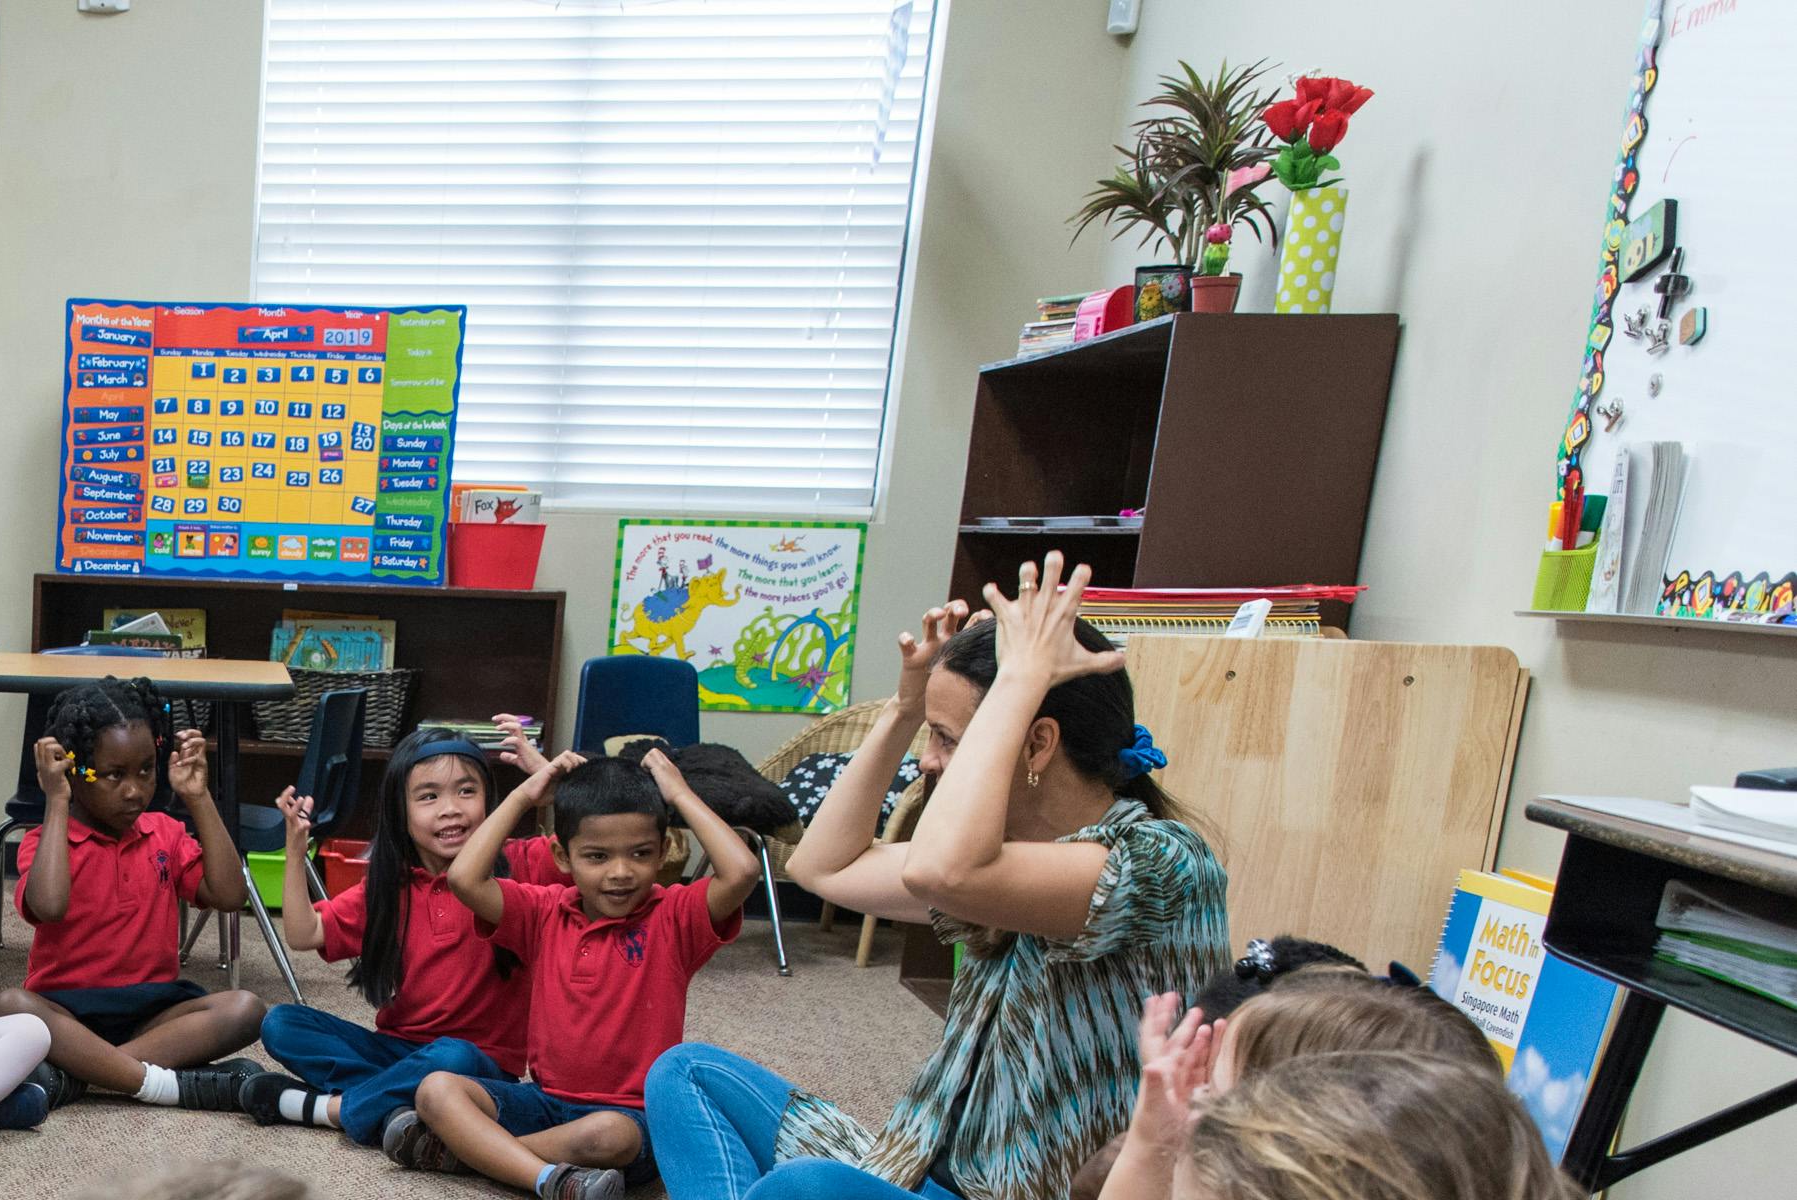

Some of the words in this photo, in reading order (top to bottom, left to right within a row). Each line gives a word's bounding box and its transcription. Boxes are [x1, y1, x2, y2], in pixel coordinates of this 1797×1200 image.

[173, 306, 205, 316] Season
[258, 308, 287, 317] Month
[344, 310, 363, 319] Year
[76, 314, 110, 326] Months
[110, 317, 118, 326] of
[121, 317, 132, 326] the
[132, 316, 152, 327] Year
[97, 328, 137, 345] January
[262, 327, 289, 342] April
[324, 330, 371, 344] 2019
[160, 348, 182, 357] Sunday
[192, 349, 215, 357] Monday
[225, 350, 249, 358] Tuesday
[289, 351, 317, 359] Thursday
[327, 352, 347, 360] Friday
[91, 356, 135, 371] February
[200, 363, 207, 377] 1
[97, 373, 128, 384] March
[230, 369, 239, 382] 2
[264, 368, 273, 382] 3
[299, 367, 309, 380] 4
[331, 370, 341, 383] 5
[365, 368, 375, 382] 6
[161, 399, 171, 412] 7
[193, 400, 203, 413] 8
[227, 402, 237, 415] 9
[258, 400, 275, 414] 10
[293, 403, 307, 417] 11
[326, 405, 342, 418] 12
[99, 409, 119, 421] May
[355, 423, 372, 437] 13
[382, 420, 403, 433] Days
[404, 420, 412, 430] of
[413, 420, 423, 430] the
[423, 419, 447, 430] Week
[97, 430, 121, 441] June
[157, 429, 173, 443] 14
[191, 431, 208, 445] 15
[225, 432, 241, 445] 16
[255, 432, 273, 447] 17
[322, 432, 338, 447] 19
[289, 438, 305, 451] 18
[354, 437, 372, 450] 20
[396, 437, 427, 450] Sunday
[99, 449, 120, 461] July
[156, 458, 172, 473] 21
[189, 461, 207, 474] 22
[255, 463, 273, 477] 24
[392, 458, 423, 470] Monday
[88, 469, 124, 484] August
[223, 468, 241, 481] 23
[289, 472, 307, 486] 25
[322, 469, 340, 483] 26
[392, 478, 423, 489] Tuesday
[83, 486, 135, 501] September
[154, 497, 172, 512] 28
[186, 499, 205, 513] 29
[220, 498, 240, 511] 30
[354, 498, 375, 513] 27
[474, 499, 494, 514] Fox
[85, 510, 127, 520] October
[385, 515, 423, 528] Thursday
[86, 529, 133, 541] November
[389, 536, 414, 549] Friday
[626, 565, 638, 581] The
[635, 544, 652, 564] more
[652, 532, 671, 544] that
[674, 532, 691, 542] you
[715, 536, 730, 550] the
[729, 546, 750, 560] more
[752, 553, 779, 572] things
[781, 562, 798, 572] you
[801, 556, 816, 567] will
[83, 560, 132, 571] December
[381, 556, 418, 568] Saturday
[738, 568, 753, 580] The
[754, 575, 776, 586] more
[779, 577, 798, 587] that
[801, 575, 818, 588] you
[744, 586, 758, 598] the
[759, 592, 781, 602] more
[783, 593, 811, 606] places
[836, 571, 850, 589] go!
[1479, 915, 1530, 957] Math
[1528, 939, 1540, 959] in
[1461, 991, 1499, 1016] Singapore
[1499, 1006, 1521, 1025] Math
[1485, 1021, 1514, 1040] Cavendish
